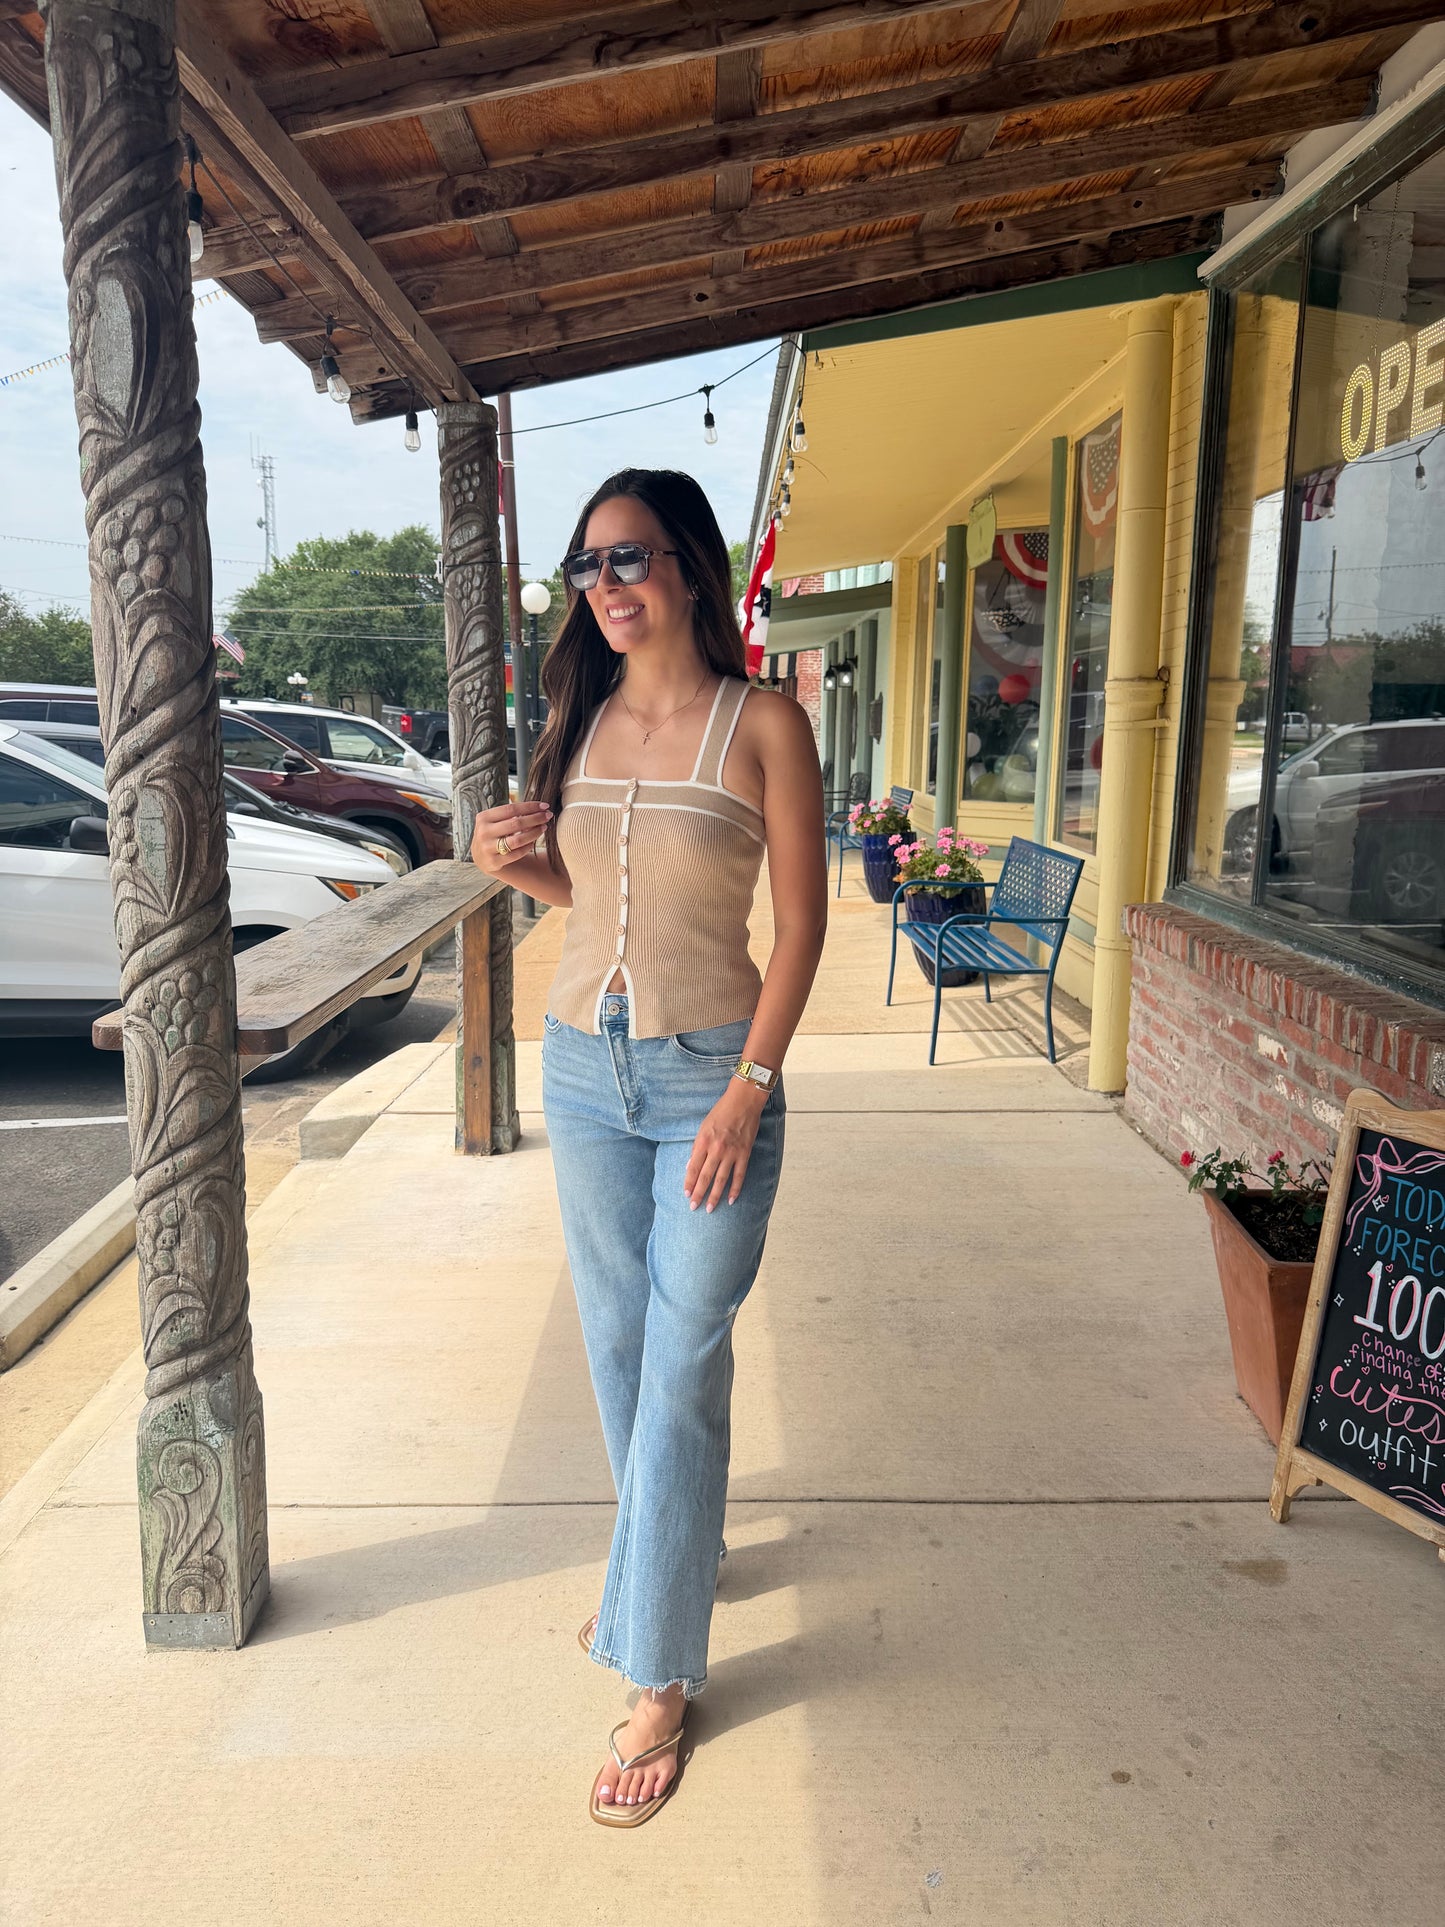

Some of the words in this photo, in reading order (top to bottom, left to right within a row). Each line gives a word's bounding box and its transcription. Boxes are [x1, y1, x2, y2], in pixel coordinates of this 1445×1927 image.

[1348, 1343, 1413, 1390] finding
[1424, 1362, 1443, 1381] of
[1339, 1418, 1438, 1485] outfit
